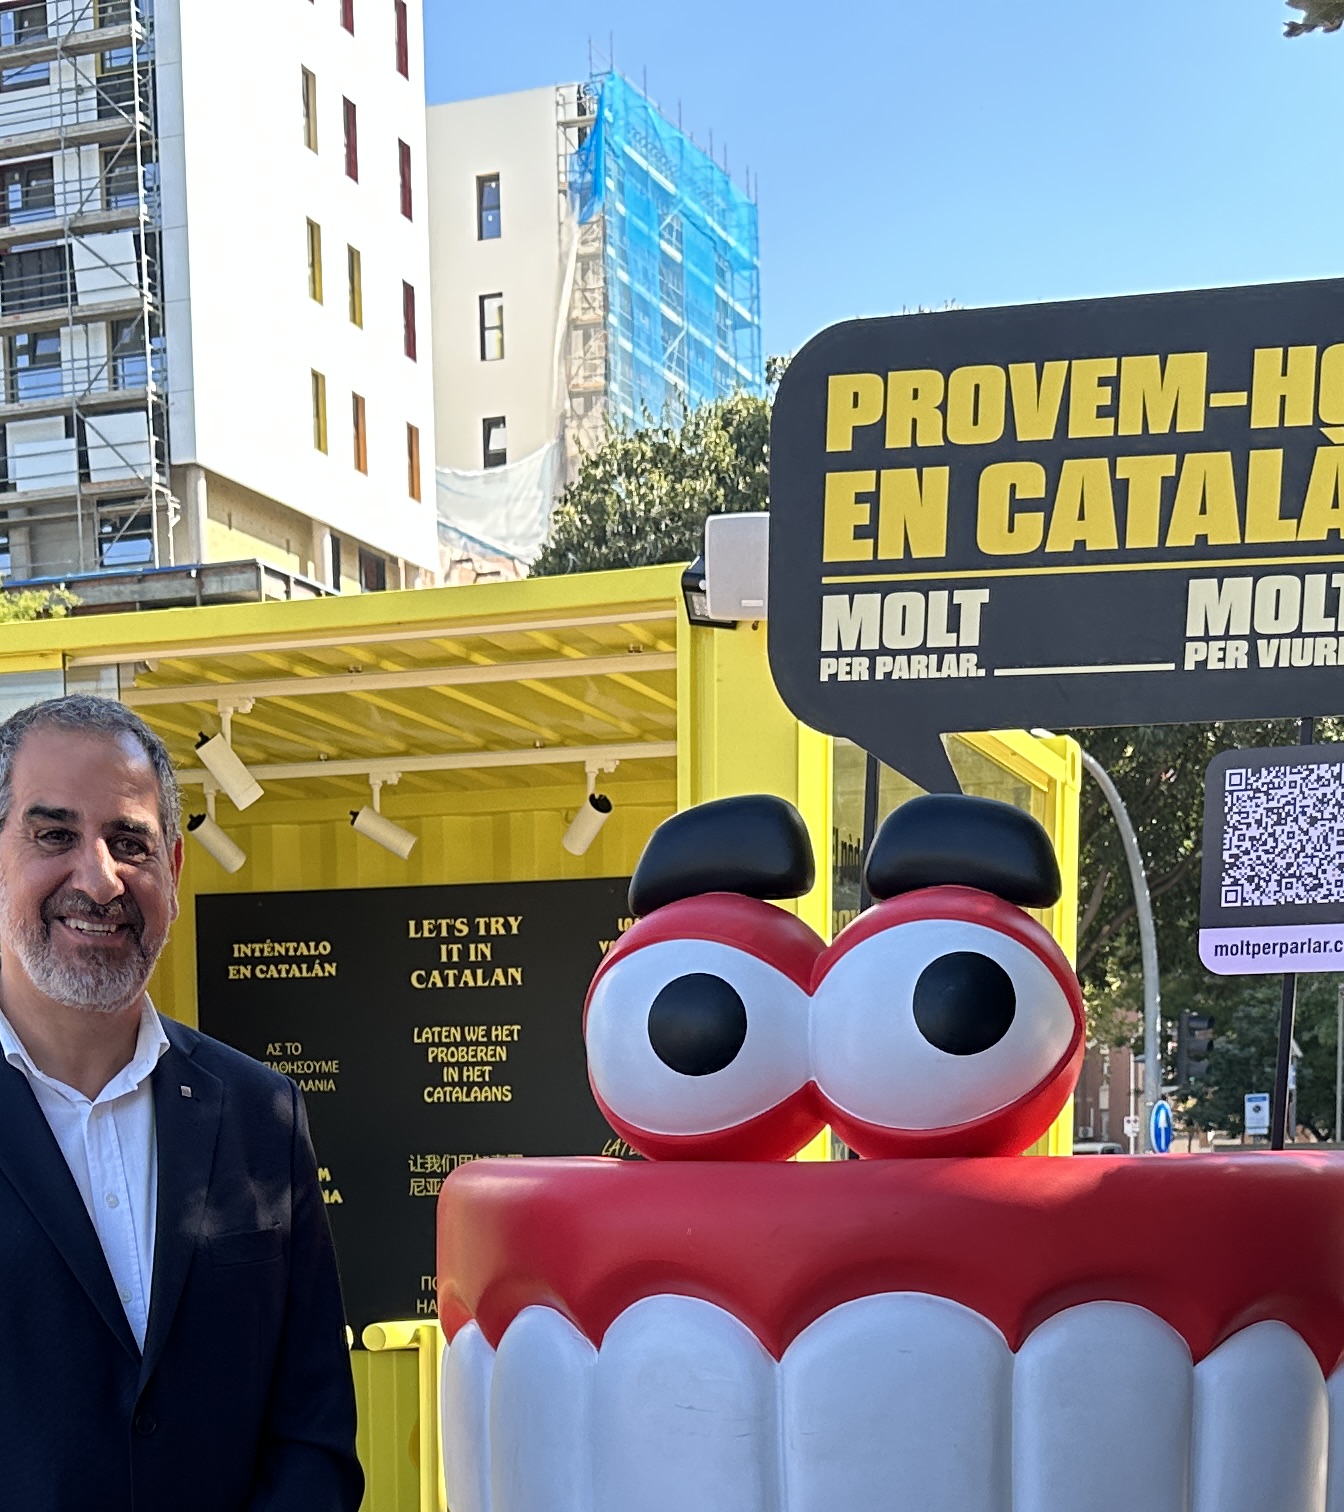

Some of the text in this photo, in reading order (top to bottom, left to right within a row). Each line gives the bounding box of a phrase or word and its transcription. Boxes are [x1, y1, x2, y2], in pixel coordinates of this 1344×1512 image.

[822, 465, 949, 564] EN
[821, 588, 989, 652] MOLT
[1184, 640, 1247, 671] PER
[819, 652, 986, 682] PER PARLAR.
[408, 915, 523, 939] LET'S TRY
[233, 938, 331, 958] INTÉNTALO
[439, 942, 492, 962] IT IN
[228, 959, 337, 980] EN CATALÁN
[410, 967, 523, 989] CATALAN
[414, 1025, 521, 1043] LATEN WE HET
[428, 1045, 507, 1063] PROBEREN
[443, 1066, 492, 1082] IN HET
[424, 1085, 512, 1103] CATALAANS
